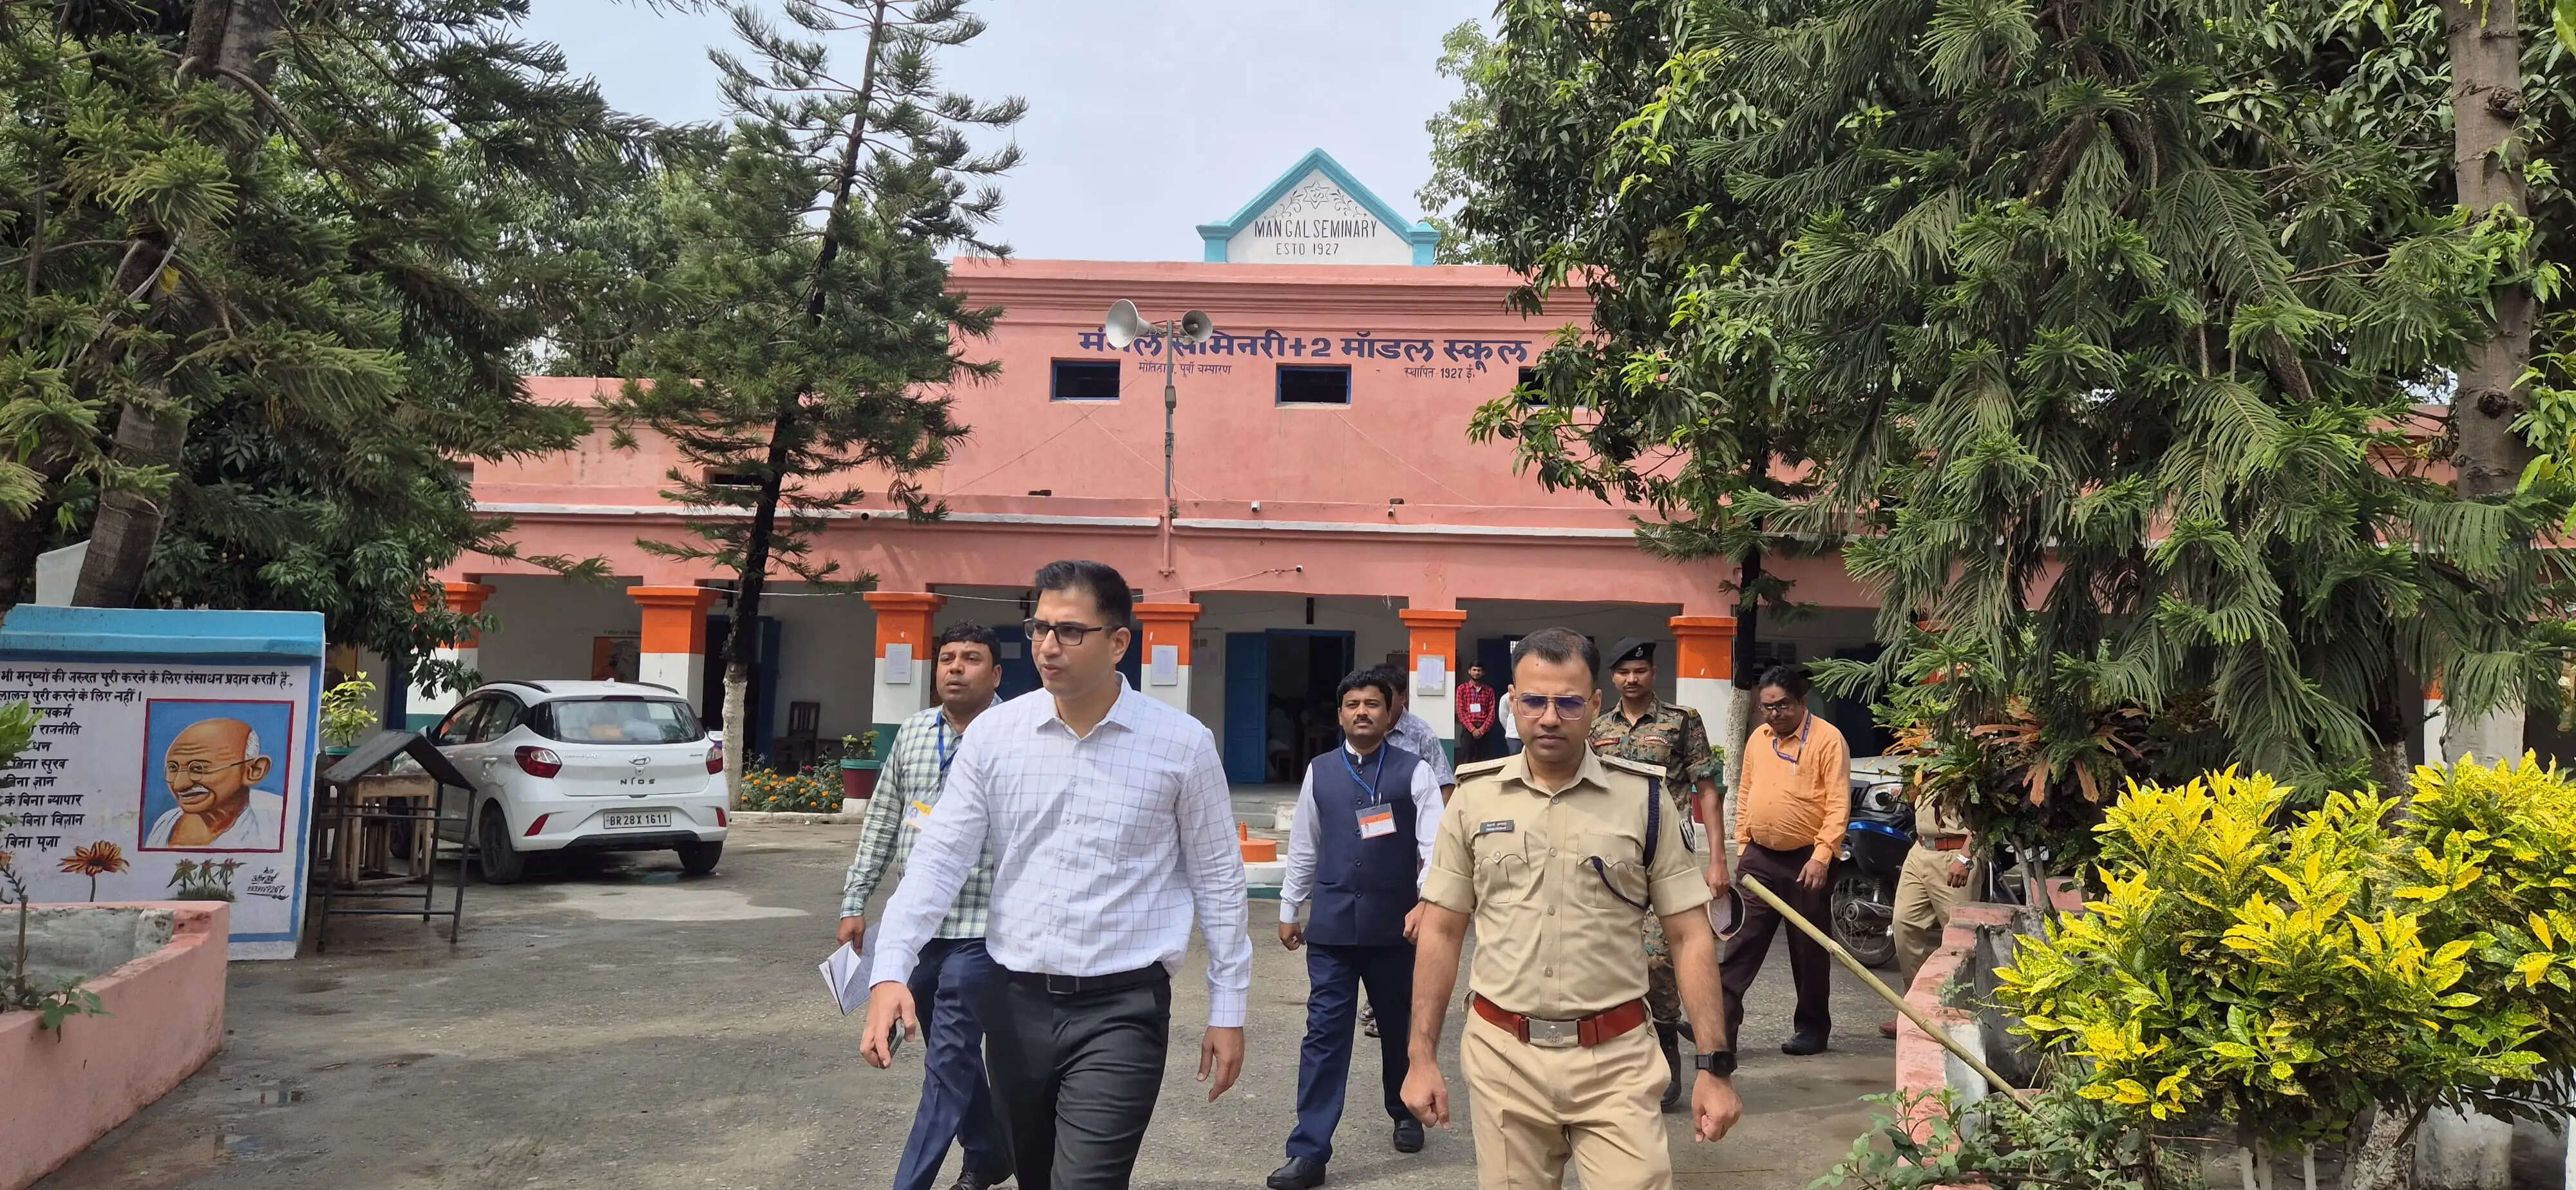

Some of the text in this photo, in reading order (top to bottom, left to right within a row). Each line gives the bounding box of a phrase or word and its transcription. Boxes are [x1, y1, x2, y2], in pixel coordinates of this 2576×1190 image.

[1313, 220, 1377, 238] SEMINARY
[1276, 243, 1340, 255] ESTD 1927
[1078, 326, 1165, 356] मंल
[1340, 331, 1434, 363] मॉडल
[1443, 339, 1532, 373] स्कूल
[1403, 365, 1435, 379] स्थापित
[1441, 368, 1463, 379] 1927
[16, 668, 52, 686] मनुष्यों
[52, 668, 67, 683] की
[100, 670, 118, 686] पुरी
[121, 670, 148, 684] करने
[149, 670, 159, 684] के
[160, 670, 182, 685] लिए
[184, 670, 225, 685] संसाधन
[225, 673, 251, 687] प्रदान
[251, 672, 278, 685] करती
[32, 688, 53, 704] पुरी
[52, 688, 78, 701] करने
[78, 688, 88, 701] के
[90, 688, 113, 702] लिए
[39, 722, 82, 735] राजनीति
[33, 777, 57, 789] ज्ञान
[17, 792, 46, 807] बिना
[47, 794, 84, 807] व्यापार
[20, 812, 48, 827] बिना
[51, 811, 86, 829] विज्ञान
[5, 833, 62, 853] बिना पूजा
